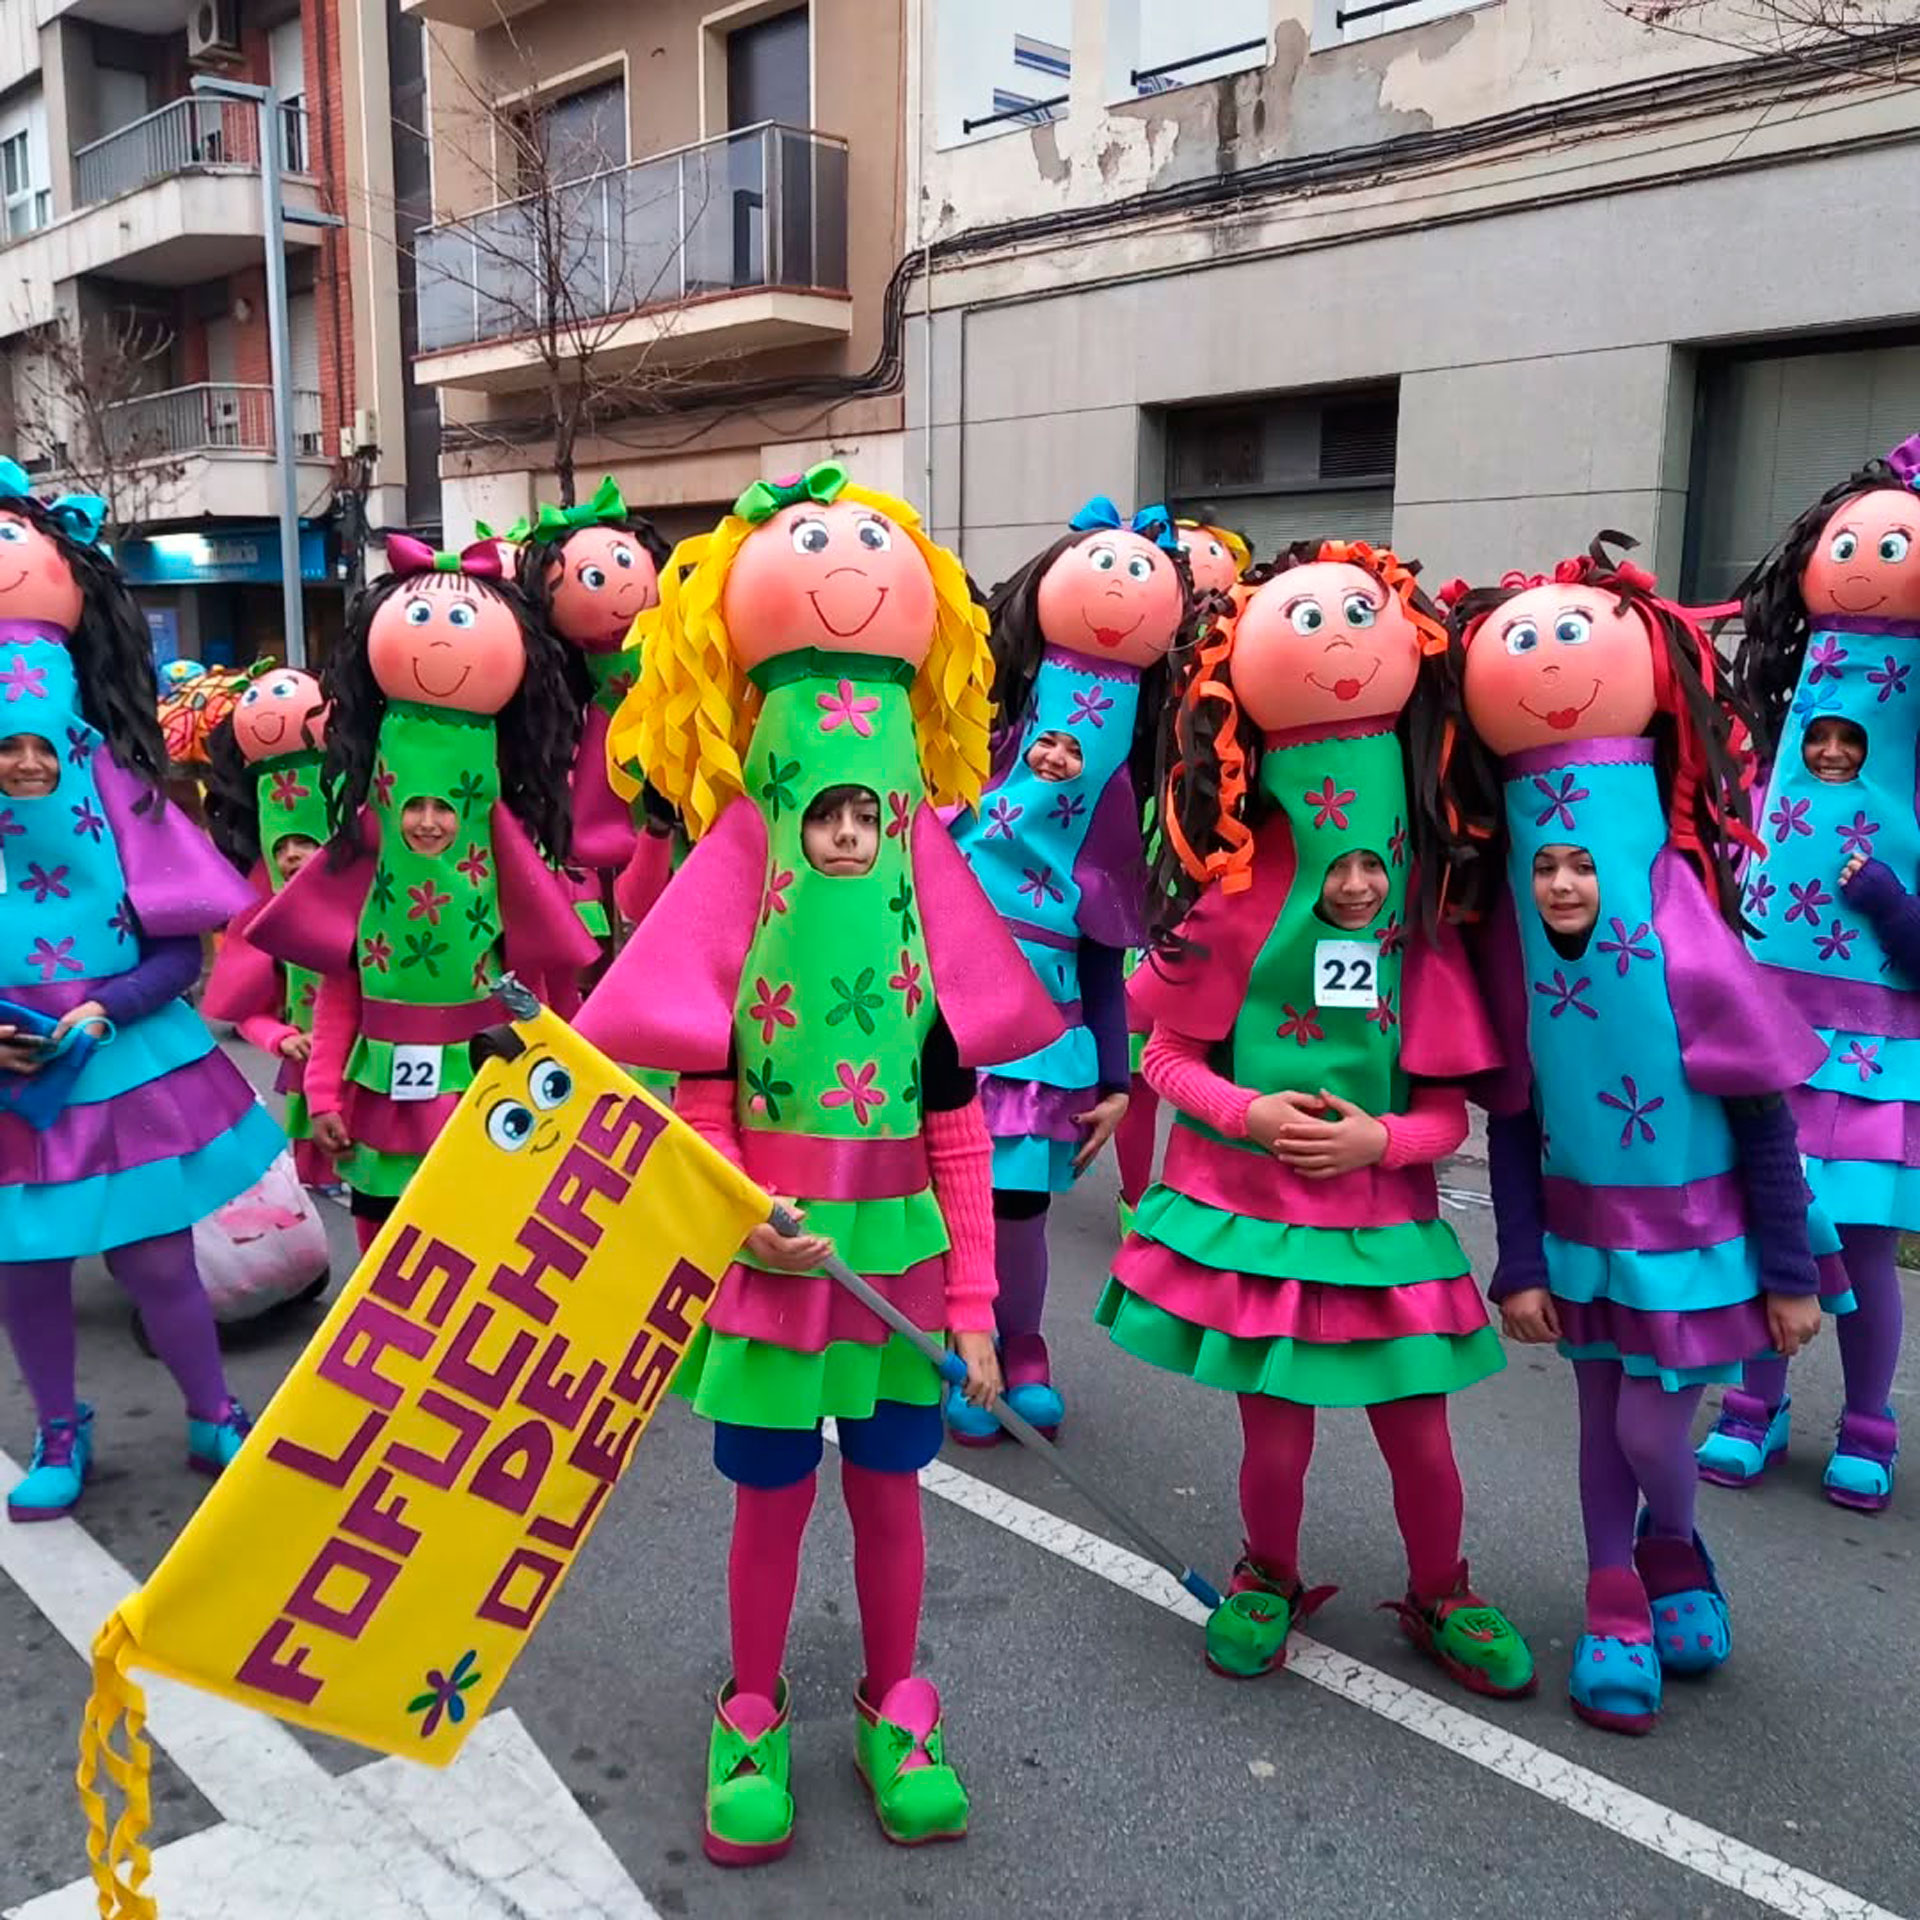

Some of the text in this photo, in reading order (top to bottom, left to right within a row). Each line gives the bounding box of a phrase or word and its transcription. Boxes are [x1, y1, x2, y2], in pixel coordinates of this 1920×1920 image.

[395, 1061, 434, 1086] 22
[1323, 959, 1373, 991] 22
[235, 1091, 670, 1705] FOFUCHAS
[268, 1224, 476, 1490] LAS
[467, 1333, 606, 1516] DE
[476, 1257, 717, 1631] OLESA
